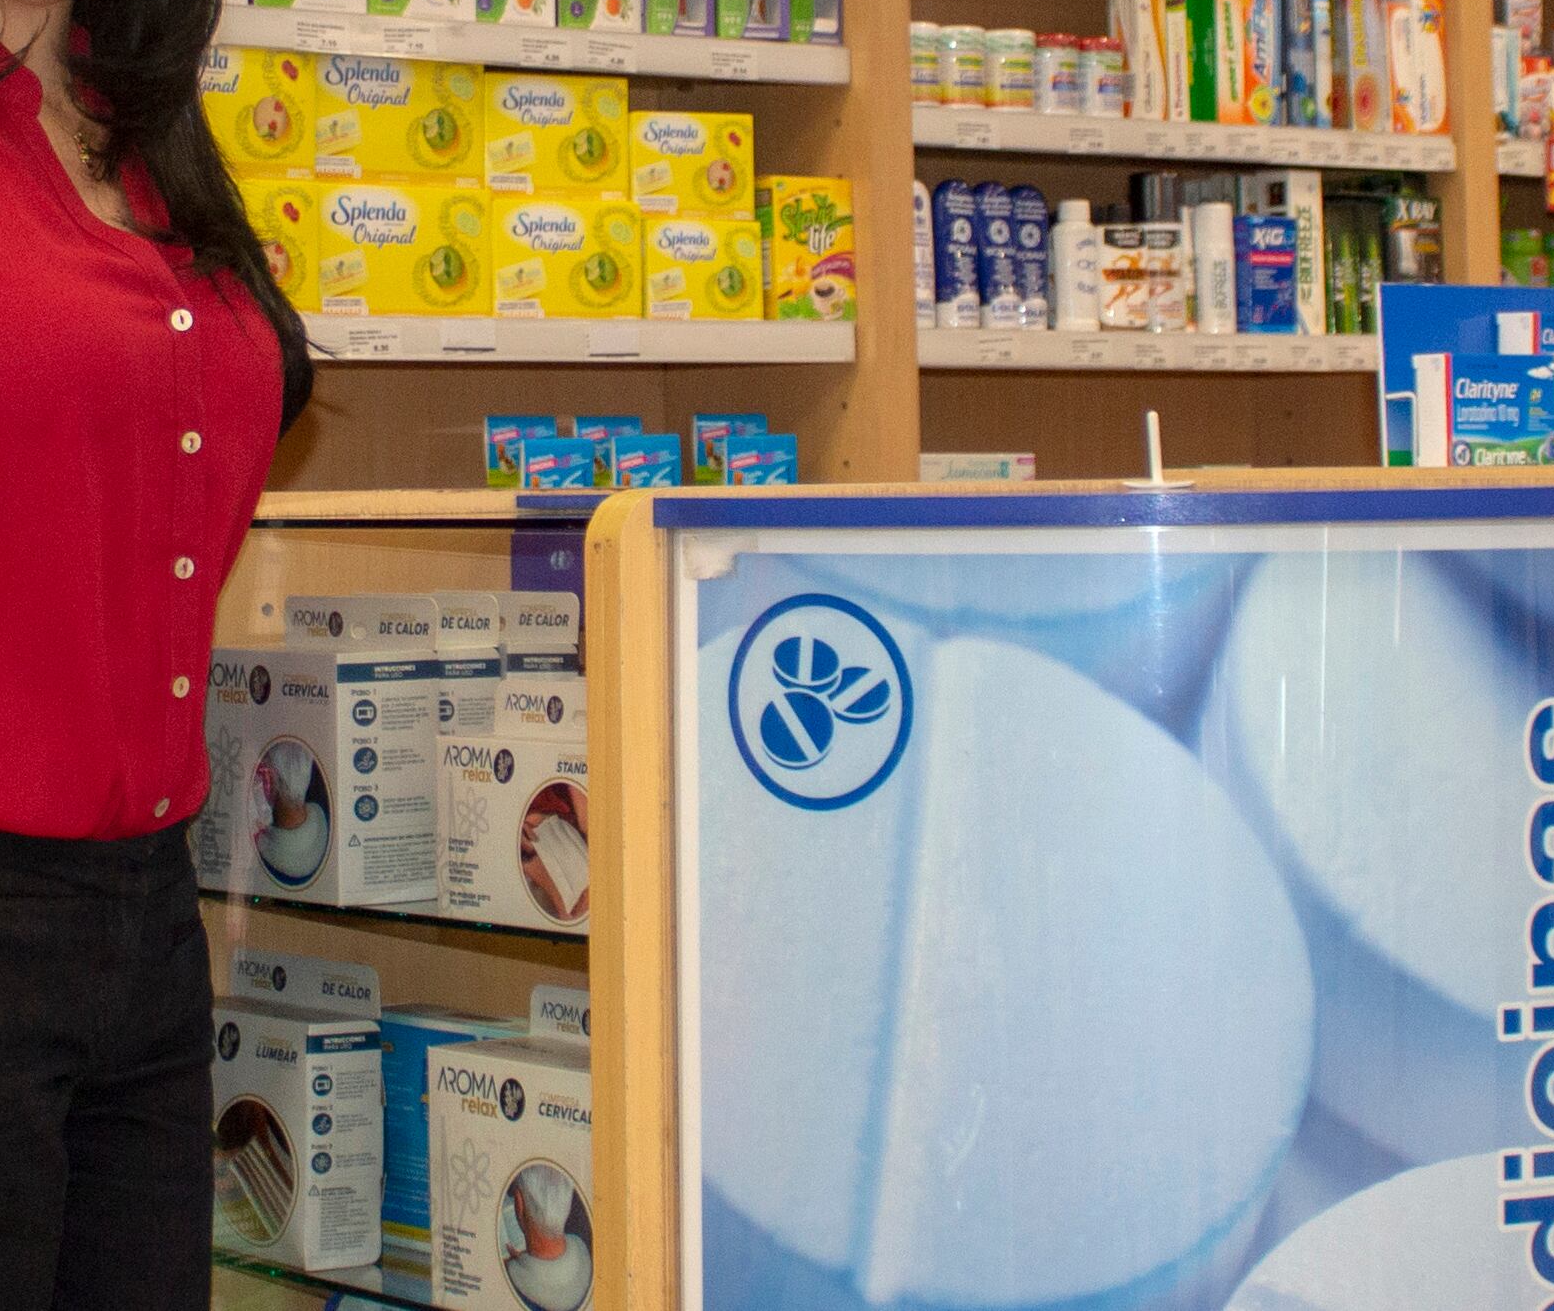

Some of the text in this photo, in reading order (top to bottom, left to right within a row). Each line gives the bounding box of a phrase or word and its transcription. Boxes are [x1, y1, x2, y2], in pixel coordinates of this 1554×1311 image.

[326, 55, 400, 86] Splenda
[347, 83, 411, 110] Original
[503, 86, 565, 109] Splenda
[521, 109, 573, 127] Original
[644, 121, 699, 142] Splenda
[659, 141, 706, 157] Original
[332, 195, 406, 225] Splenda
[513, 212, 577, 237] Splenda
[353, 225, 418, 248] Original
[531, 235, 584, 252] Original
[658, 227, 710, 247] Splenda
[674, 247, 717, 262] Original
[1456, 378, 1519, 400] Clarityne
[379, 622, 430, 637] DE CALOR
[441, 616, 491, 631] DE CALOR
[519, 613, 570, 628] DE CALOR
[282, 683, 330, 700] CERVICAL
[505, 693, 547, 712] AROMA
[520, 710, 546, 724] relax
[444, 746, 494, 769] AROMA
[462, 767, 493, 783] relax
[322, 981, 372, 1002] DE CALOR
[541, 1002, 582, 1022] AROMA
[256, 1045, 298, 1065] LUMBAR
[438, 1066, 499, 1100] AROMA
[461, 1096, 498, 1119] relax
